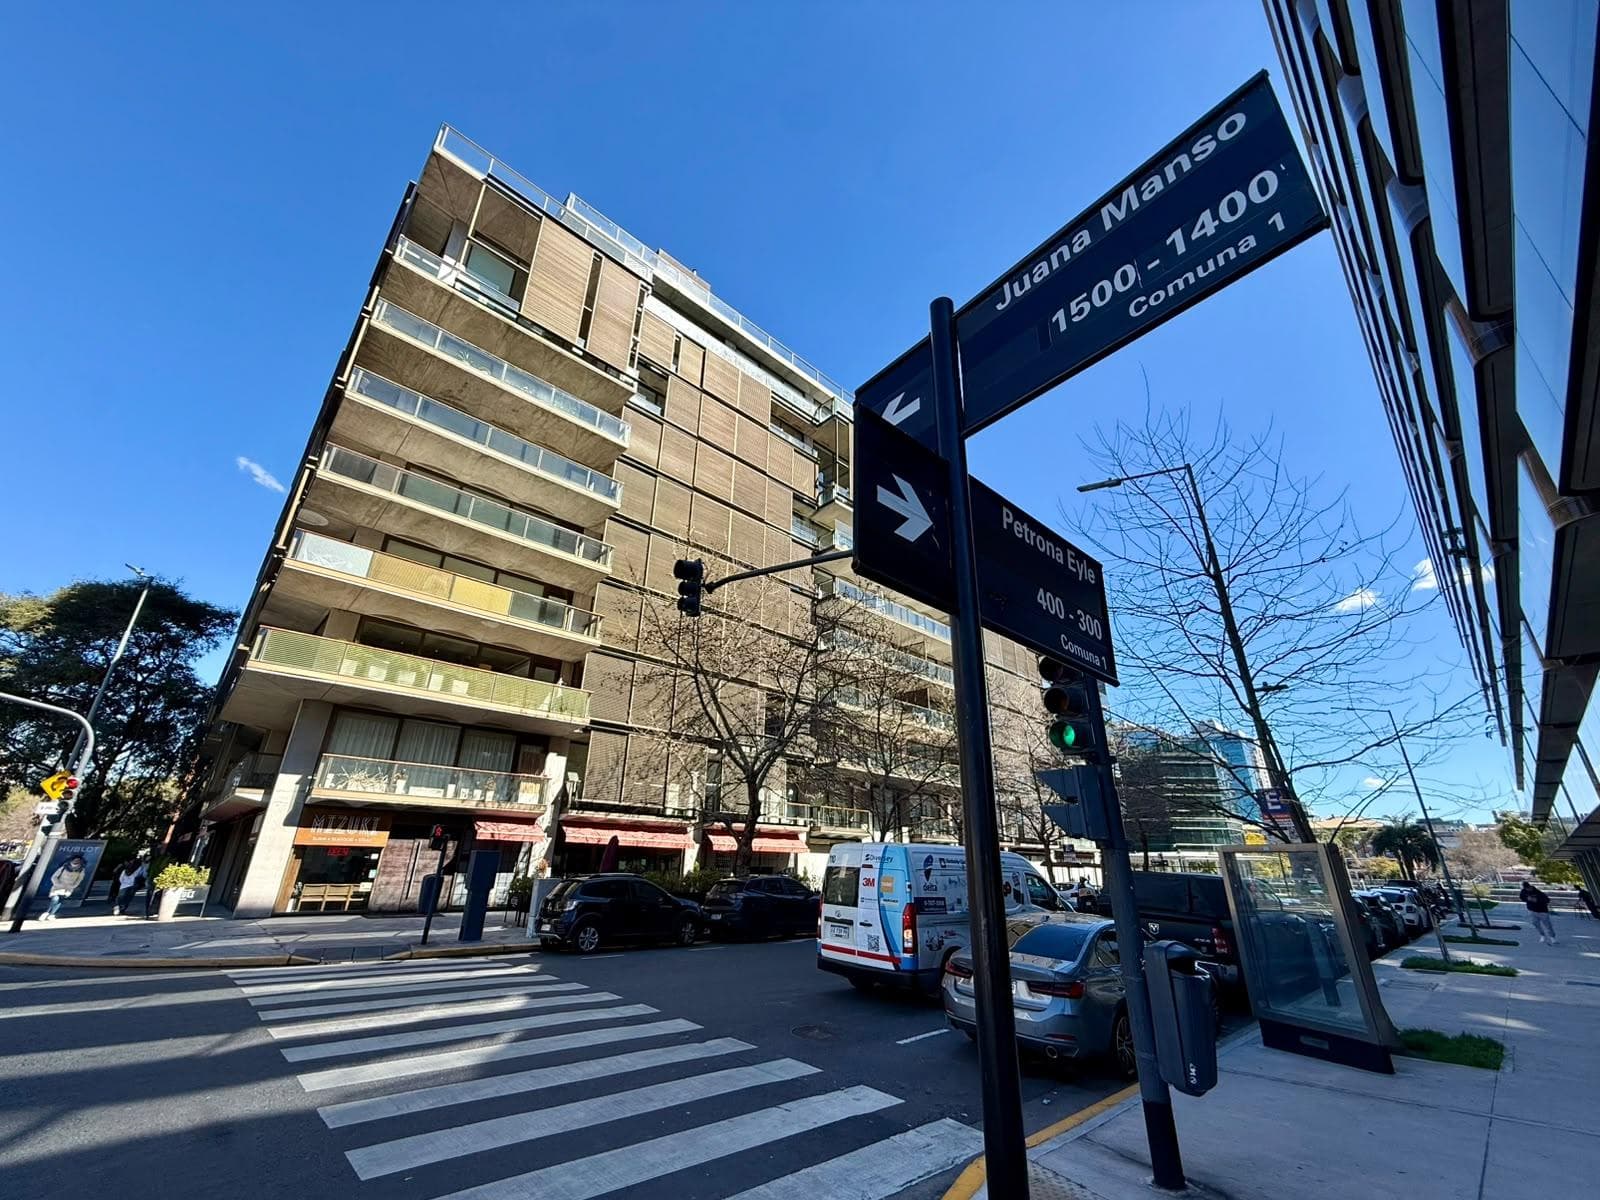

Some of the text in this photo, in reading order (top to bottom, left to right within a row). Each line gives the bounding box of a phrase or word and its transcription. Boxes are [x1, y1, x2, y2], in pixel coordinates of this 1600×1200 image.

[996, 113, 1246, 311] Juana Manso
[1052, 170, 1278, 332] 1500 - 1400
[1129, 212, 1285, 317] Comuna 1
[1002, 506, 1096, 585] Petrona Eyle
[1037, 588, 1065, 619] 400
[1077, 609, 1102, 640] 300
[1060, 634, 1108, 671] Comuna 1
[1266, 791, 1281, 809] E
[58, 845, 102, 854] HUBLOT
[862, 877, 876, 888] 3M
